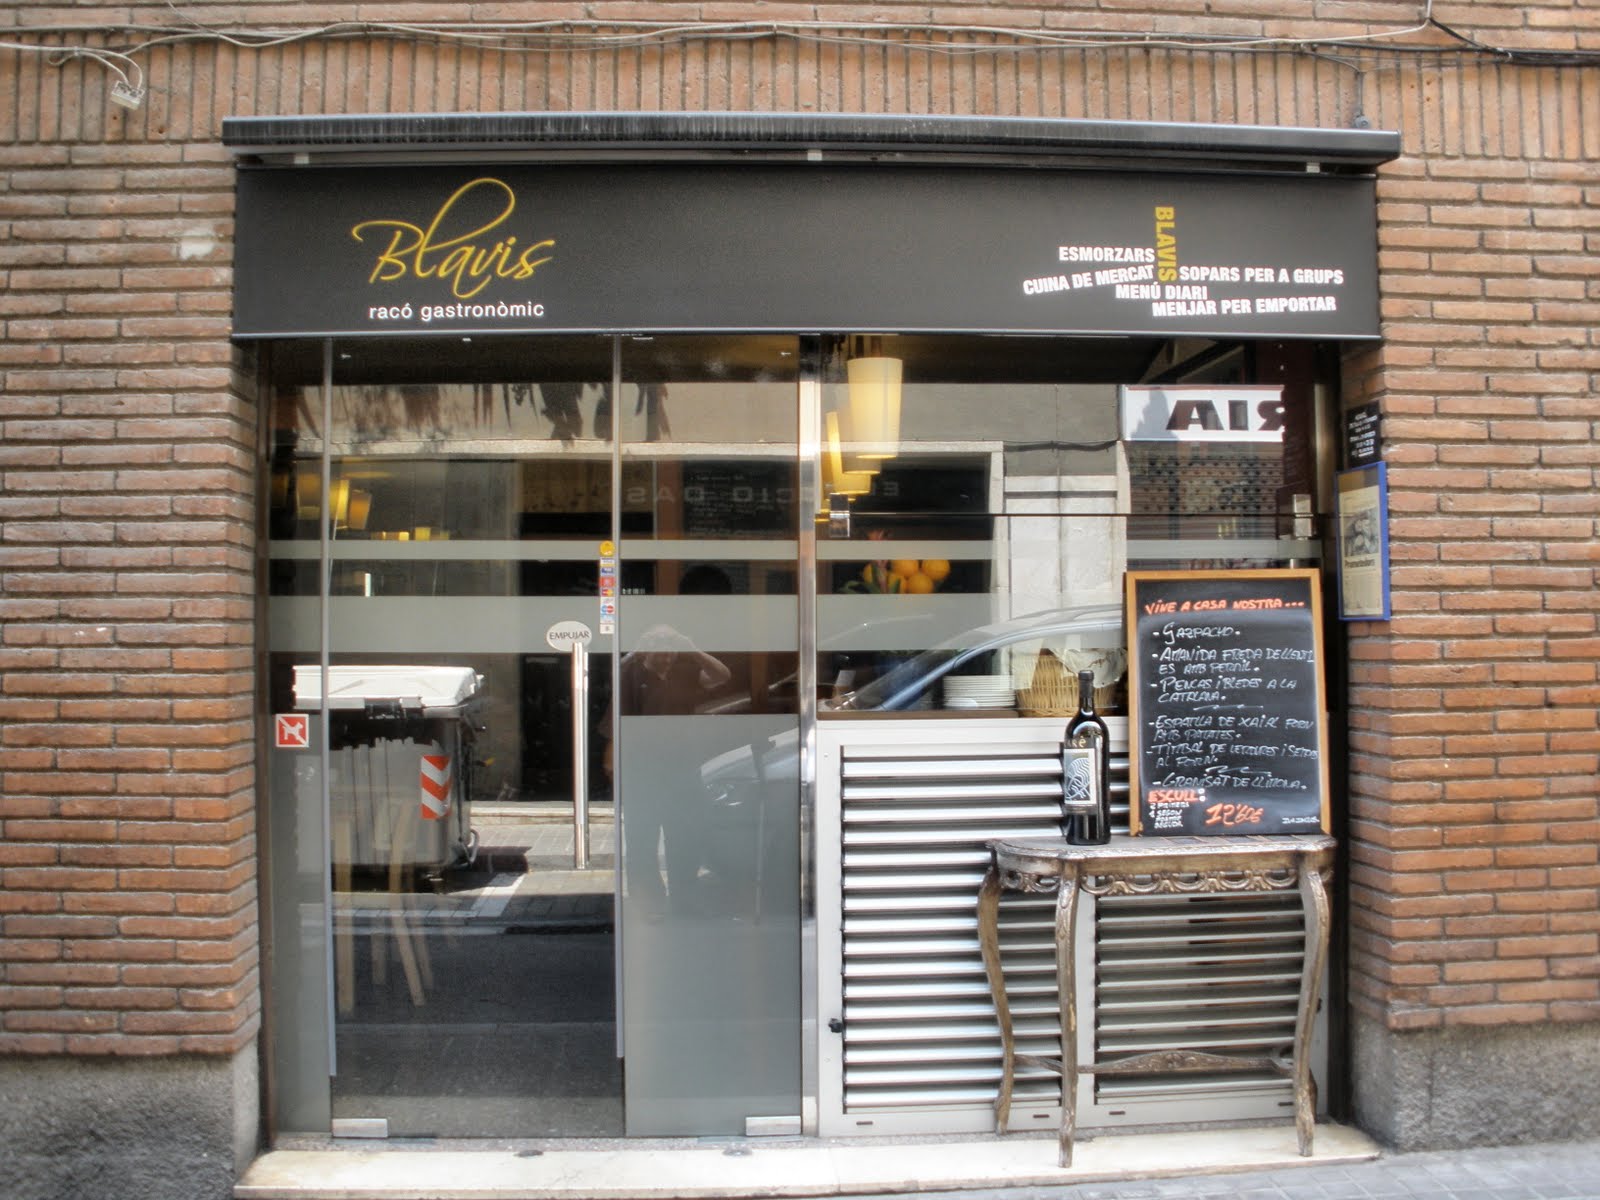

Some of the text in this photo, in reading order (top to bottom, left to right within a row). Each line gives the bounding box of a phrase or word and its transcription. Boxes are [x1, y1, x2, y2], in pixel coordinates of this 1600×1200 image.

[352, 178, 555, 298] Blavis
[1155, 206, 1178, 282] BLAVIS
[1058, 246, 1155, 263] ESMORZARS
[1023, 264, 1155, 295] CUINA DE MERCAT
[1179, 266, 1344, 285] SOPARS PER A GRUPS
[1115, 281, 1208, 300] MENÚ DIARI
[369, 300, 544, 321] racó gastronòmic
[1152, 296, 1337, 317] MENJAR PER EMPORTAR
[1181, 601, 1191, 611] A
[1194, 600, 1226, 610] CASA
[549, 629, 590, 641] EMPUJAR
[1159, 663, 1176, 674] ES
[1266, 679, 1277, 689] A
[1218, 716, 1235, 727] DE
[1209, 743, 1227, 754] DE
